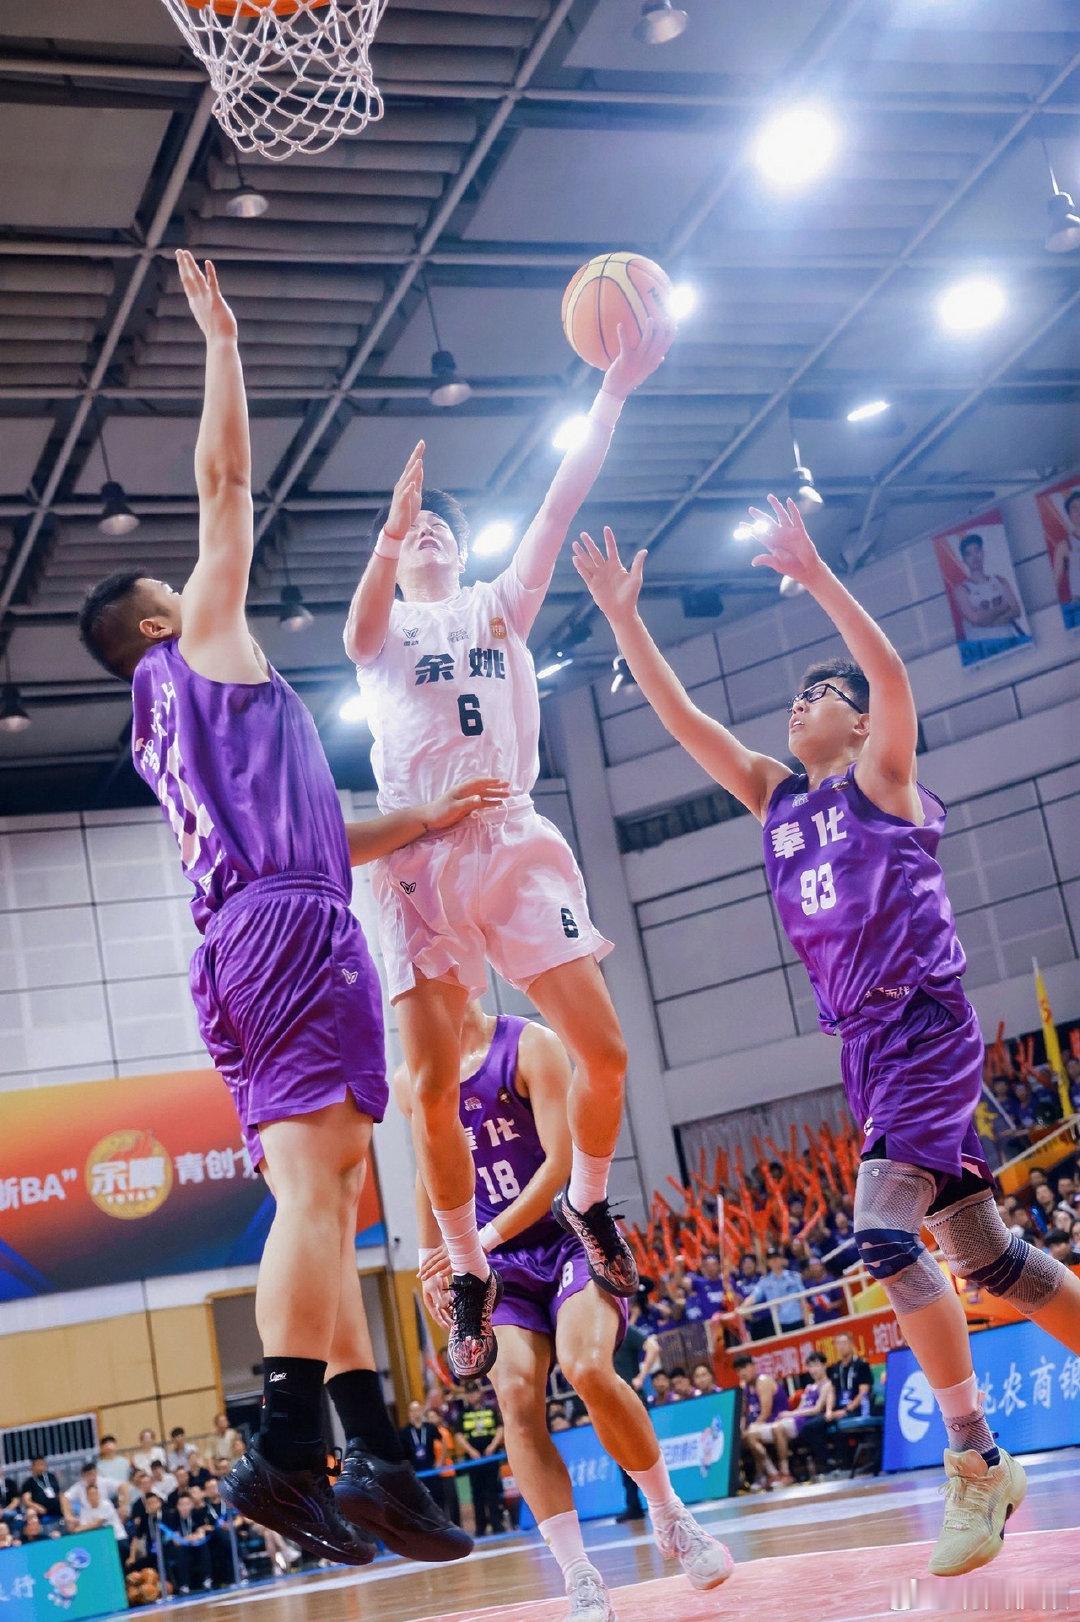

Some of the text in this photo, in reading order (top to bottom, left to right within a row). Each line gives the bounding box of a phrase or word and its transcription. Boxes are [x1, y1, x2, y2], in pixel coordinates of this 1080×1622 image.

[415, 647, 506, 685] 余姚
[457, 693, 484, 737] 6
[770, 806, 847, 859] 奉化
[800, 862, 837, 916] 93
[560, 908, 579, 938] 6
[477, 1159, 521, 1205] 18
